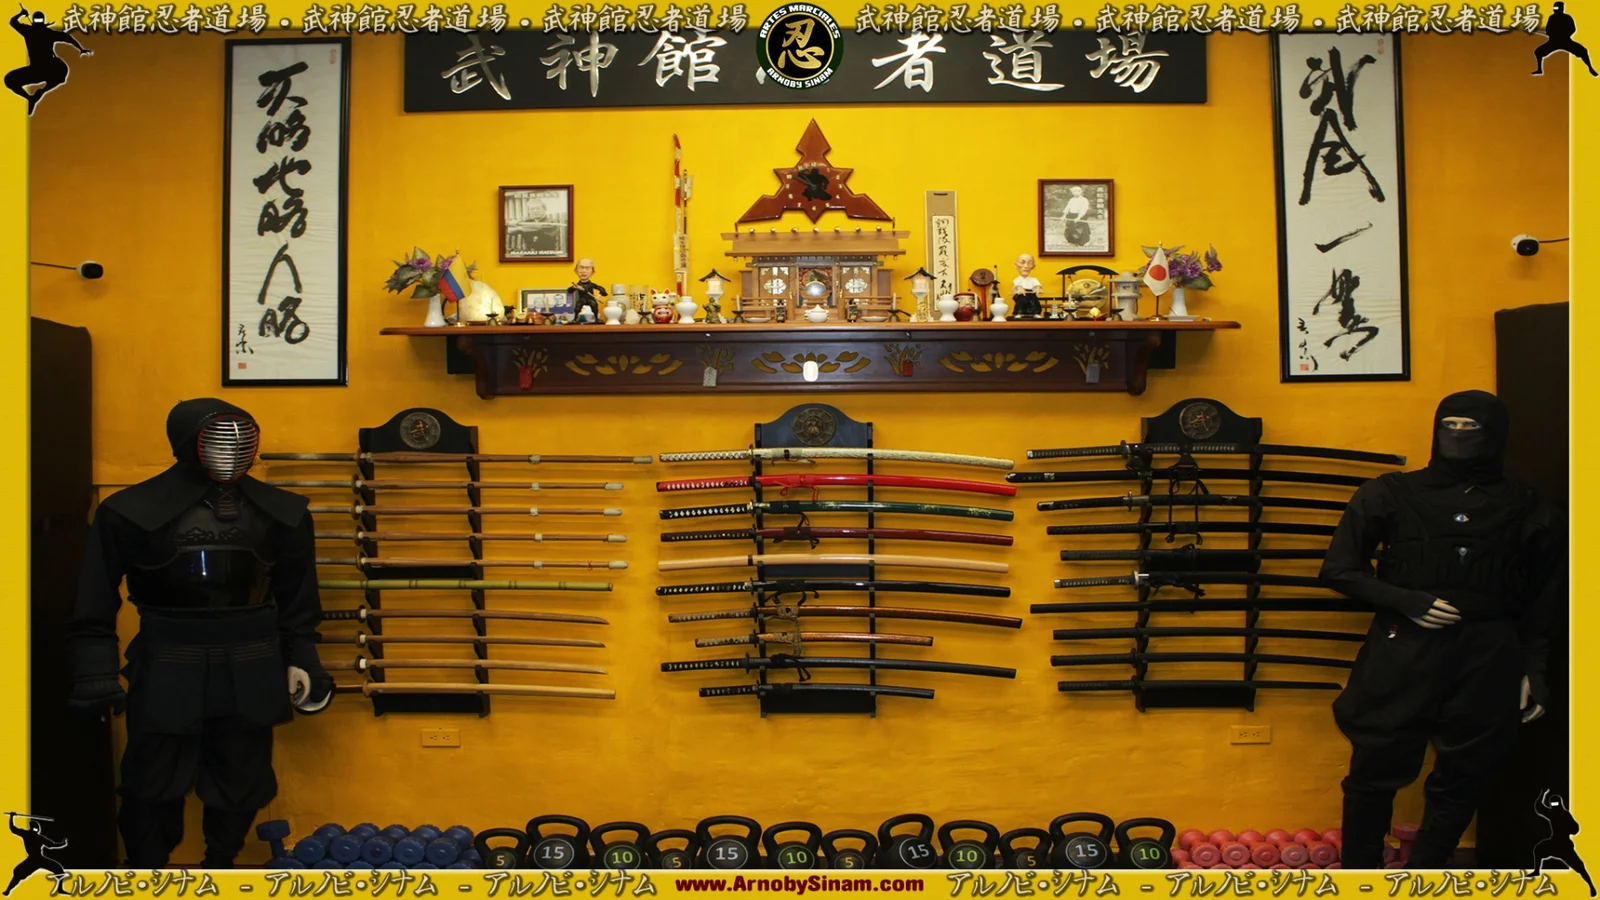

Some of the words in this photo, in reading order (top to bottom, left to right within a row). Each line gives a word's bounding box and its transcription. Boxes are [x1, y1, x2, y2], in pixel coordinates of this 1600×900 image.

[441, 30, 1169, 100] 武神館者道場
[541, 846, 565, 860] 15
[715, 847, 739, 860] 15
[907, 843, 931, 859] 15
[956, 850, 978, 862] 10
[1075, 843, 1099, 858] 15
[1139, 847, 1160, 861] 10
[496, 855, 505, 867] 5
[612, 851, 633, 864] 10
[672, 857, 682, 868] 5
[786, 851, 808, 864] 10
[845, 857, 854, 868] 5
[1027, 855, 1037, 867] 5
